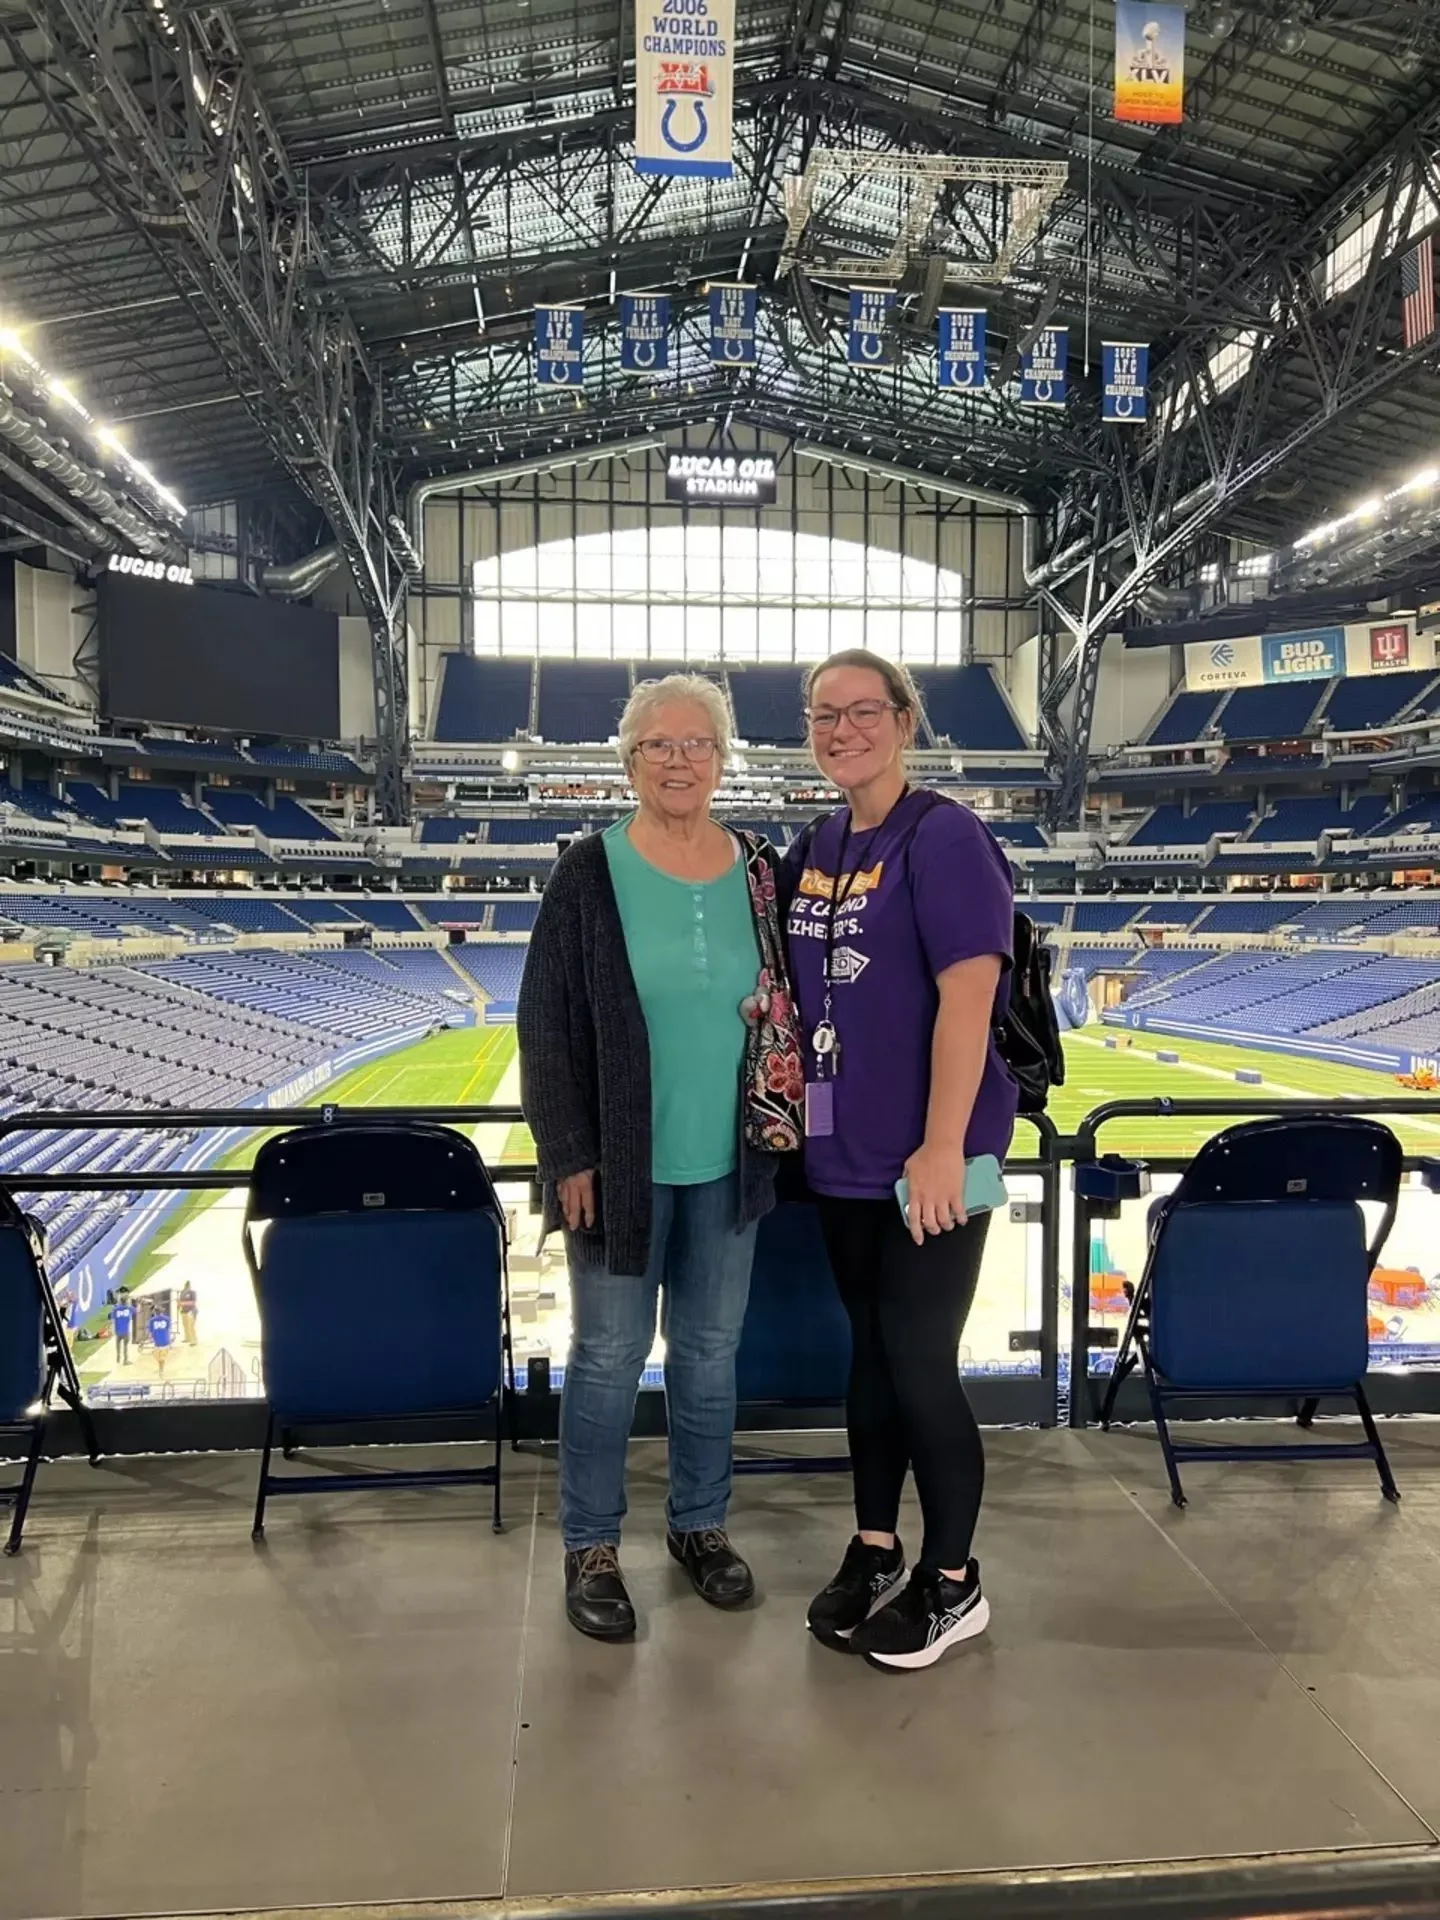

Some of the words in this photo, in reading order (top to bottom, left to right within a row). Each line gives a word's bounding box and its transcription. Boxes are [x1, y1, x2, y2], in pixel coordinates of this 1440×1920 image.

[662, 0, 708, 16] 2006
[653, 16, 718, 37] WORLD
[643, 36, 727, 57] CHAMPIONS
[720, 300, 745, 316] AFC
[860, 307, 886, 321] AFC
[631, 312, 658, 327] AFC
[546, 322, 573, 338] AFC
[951, 327, 974, 340] AFC
[1032, 342, 1057, 357] AFC
[1114, 358, 1137, 374] AFC
[668, 454, 736, 477] LUCAS
[739, 457, 775, 480] OIL
[686, 477, 758, 494] STADIUM
[108, 553, 166, 580] LUCAS
[166, 564, 195, 585] OIL
[1280, 640, 1324, 660] BUD
[1273, 654, 1334, 676] LIGHT
[1200, 671, 1247, 682] CORTEVA
[787, 917, 864, 940] LZHEER'S.
[323, 1107, 333, 1123] 8
